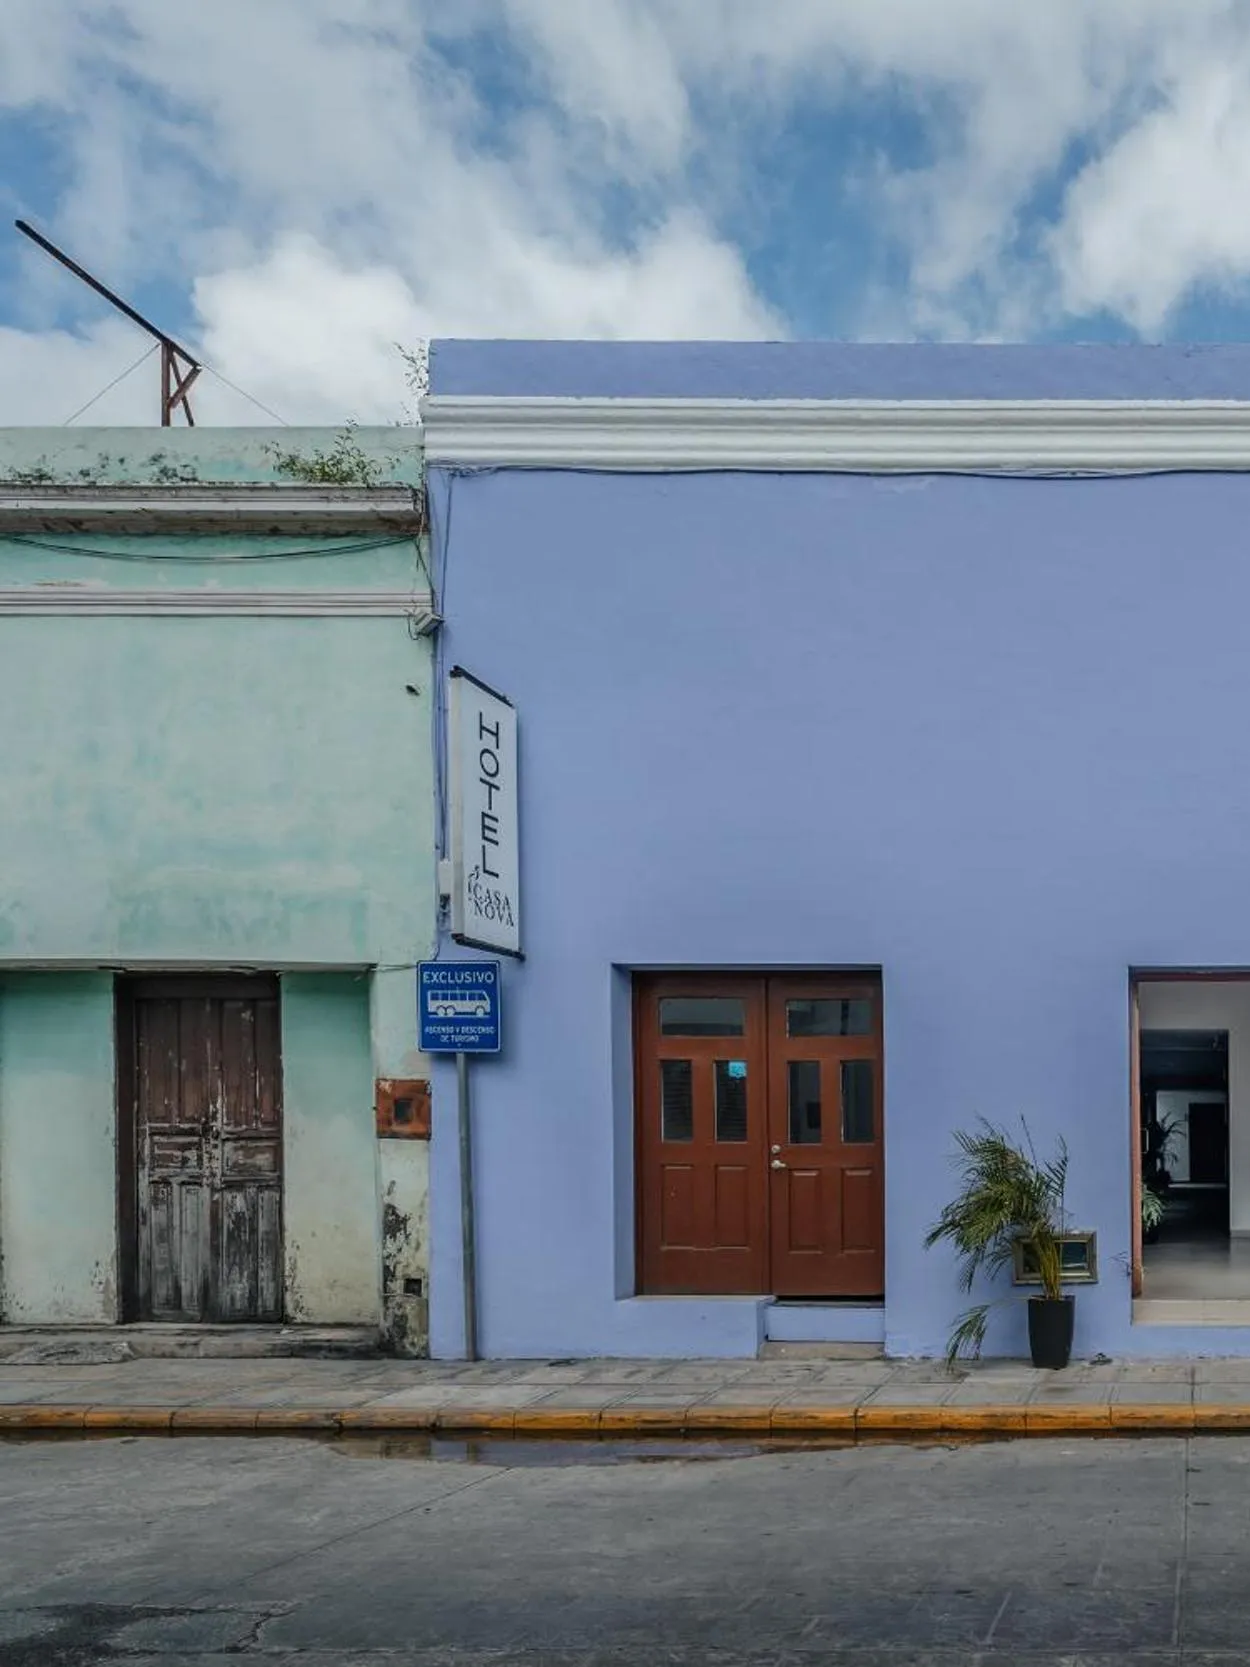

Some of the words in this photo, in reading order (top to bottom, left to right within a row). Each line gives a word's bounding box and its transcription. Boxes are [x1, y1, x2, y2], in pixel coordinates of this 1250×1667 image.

[479, 711, 500, 879] HOTEL
[473, 881, 511, 911] CASA
[473, 897, 514, 927] NOVA
[423, 971, 494, 984] EXCLUSIVO
